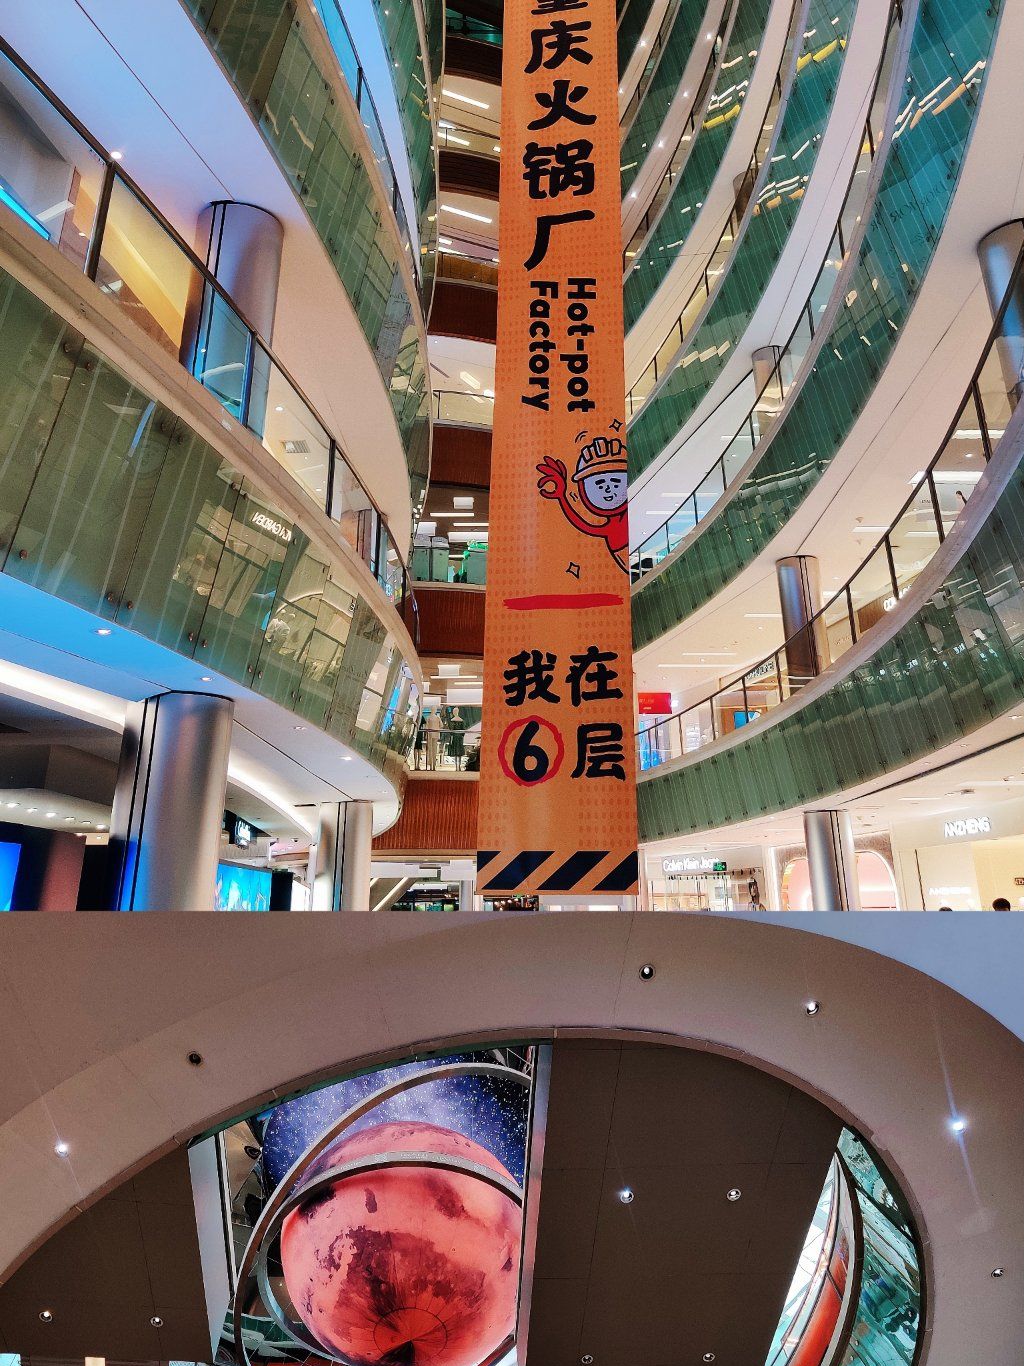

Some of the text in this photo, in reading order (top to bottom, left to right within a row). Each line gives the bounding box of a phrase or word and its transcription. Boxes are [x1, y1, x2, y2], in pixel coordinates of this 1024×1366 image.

[523, 0, 597, 272] 庆火锅厂
[521, 280, 559, 412] Factory
[560, 277, 597, 413] Hot-pot
[502, 645, 624, 708] 我在
